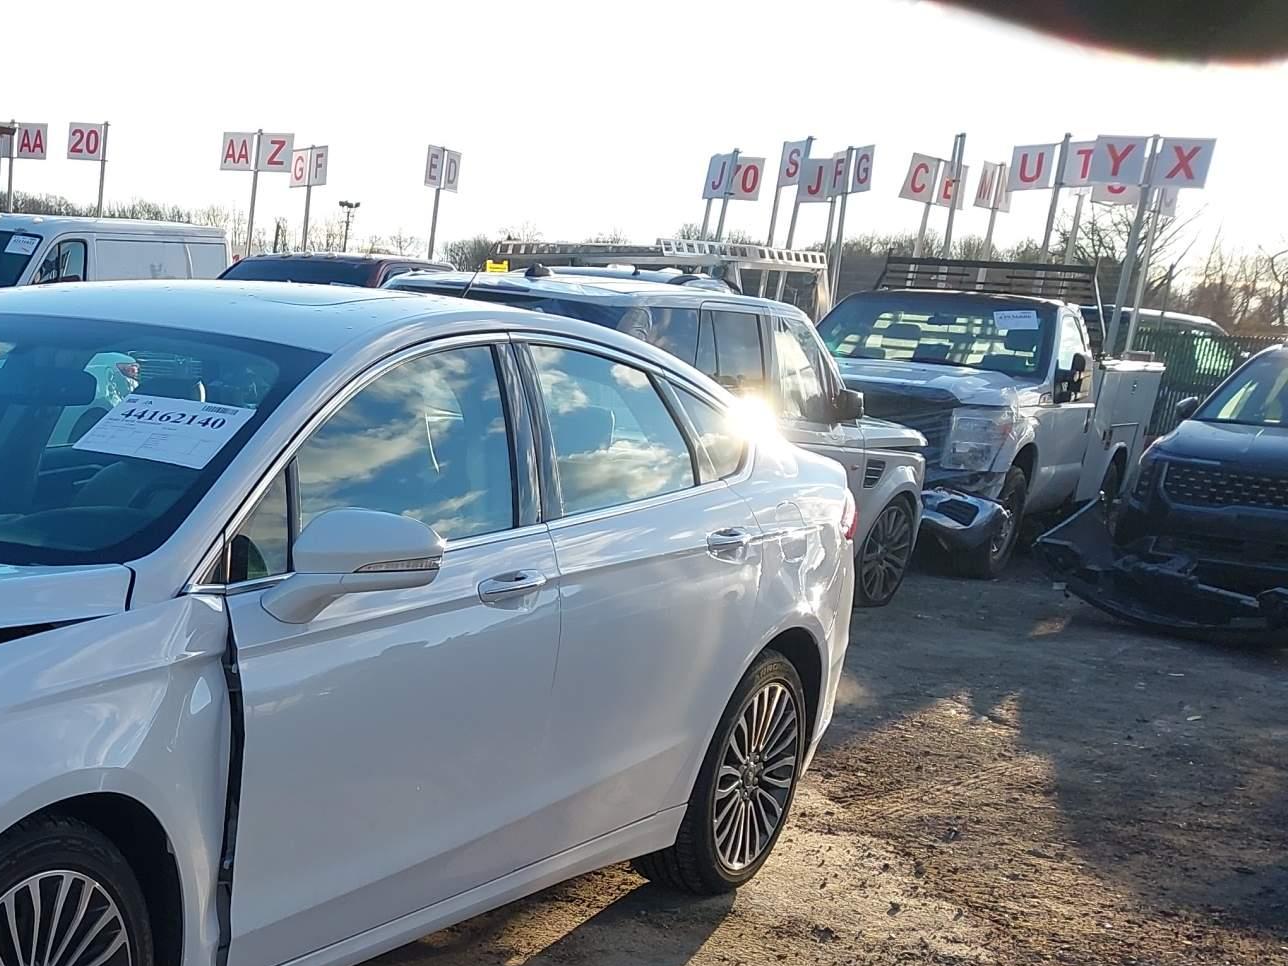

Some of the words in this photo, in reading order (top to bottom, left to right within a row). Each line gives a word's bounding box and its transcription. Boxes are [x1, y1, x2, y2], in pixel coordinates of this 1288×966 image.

[19, 129, 44, 153] AA
[70, 128, 99, 154] 20
[224, 138, 249, 164] AA
[267, 140, 286, 166] Z
[293, 155, 304, 181] G
[314, 153, 324, 179] F
[428, 154, 439, 180] E
[448, 158, 457, 185] D
[786, 149, 801, 178] S
[832, 158, 845, 188] F
[856, 154, 870, 184] G
[1019, 152, 1045, 183] U
[1076, 149, 1094, 179] T
[1106, 144, 1137, 177] Y
[1164, 145, 1202, 180] X
[711, 161, 727, 190] J
[807, 166, 824, 199] J
[911, 163, 929, 193] C
[120, 407, 227, 430] 44162140
